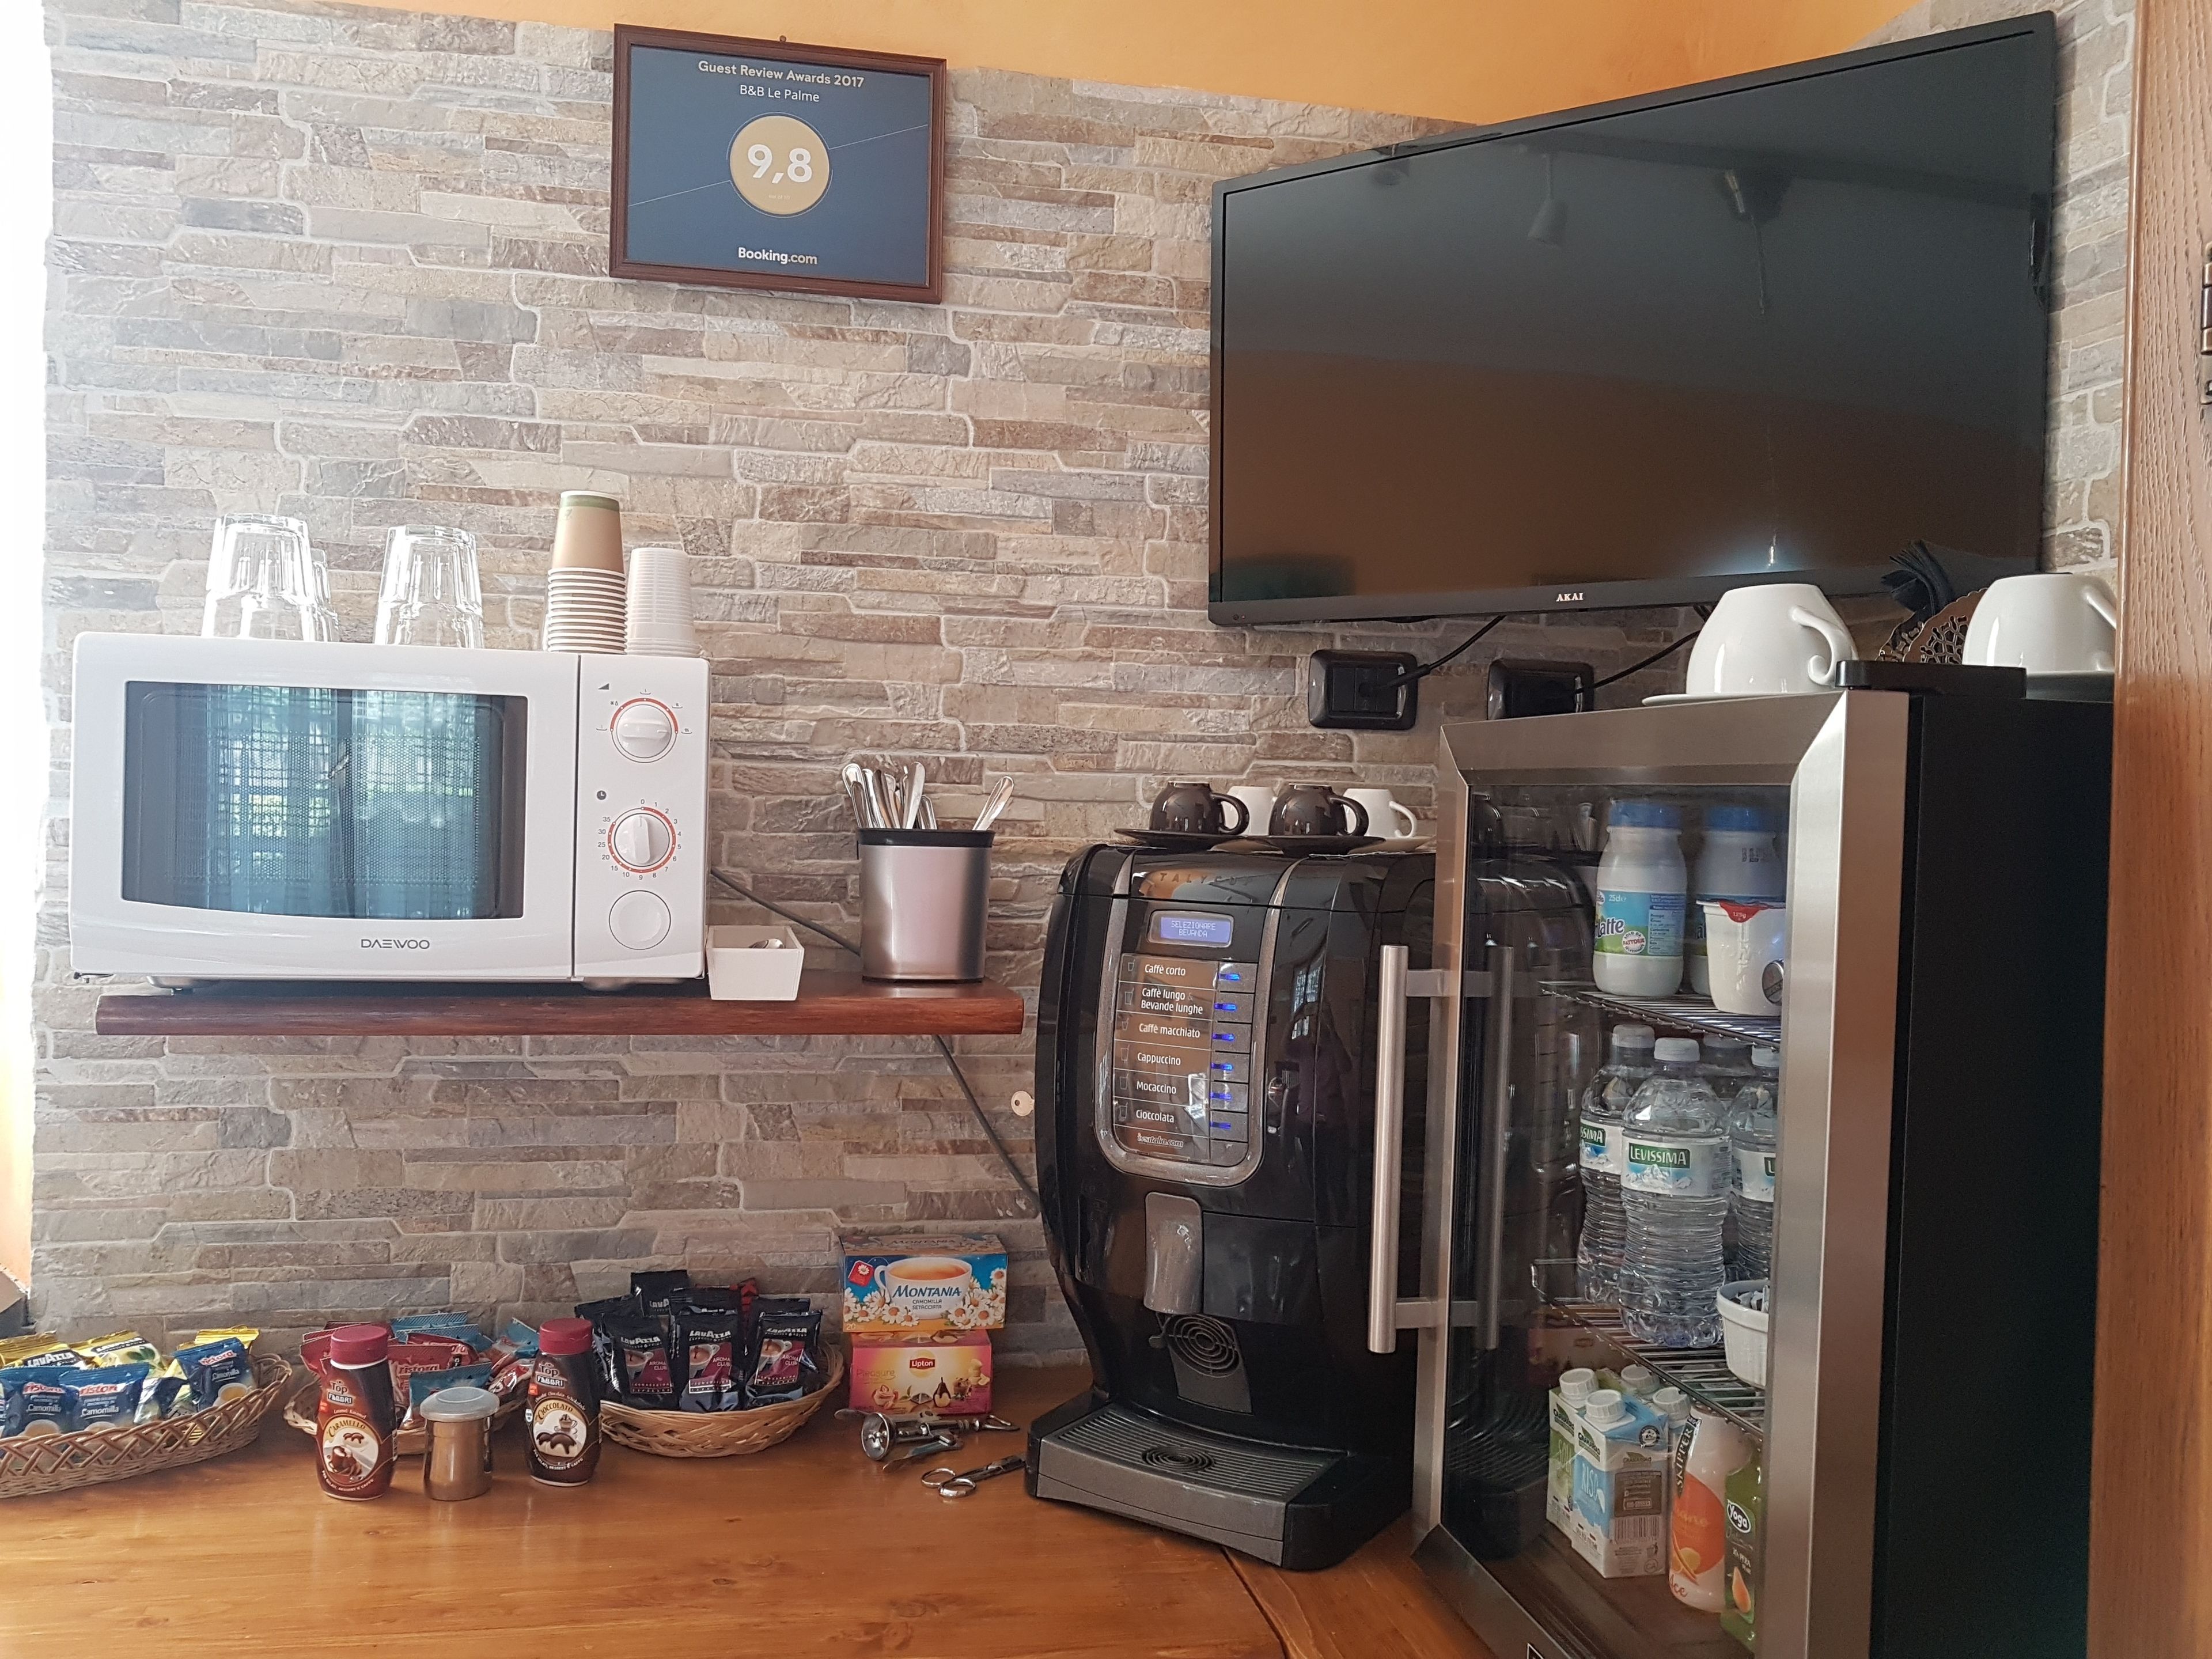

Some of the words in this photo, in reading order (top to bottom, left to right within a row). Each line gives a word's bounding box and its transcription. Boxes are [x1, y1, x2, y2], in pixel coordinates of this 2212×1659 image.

[698, 60, 737, 74] Guest
[740, 64, 783, 79] Review
[786, 70, 831, 85] Awards
[834, 74, 864, 88] 2017
[740, 85, 764, 96] B&B
[768, 87, 781, 99] Le
[785, 90, 820, 103] Palme
[748, 144, 812, 184] 9,8
[738, 247, 818, 265] Booking.com
[1556, 592, 1584, 602] AKAI
[1179, 929, 1207, 938] BEVANDA
[361, 939, 430, 949] DAEWOO
[1145, 964, 1164, 974] Caffè
[1165, 967, 1185, 976] corto
[1142, 987, 1161, 998] Caffè
[1162, 989, 1185, 1001] lungo
[1141, 999, 1173, 1011] Bevande
[1176, 1002, 1203, 1014] lunghe
[1139, 1022, 1158, 1033] Caffè
[1160, 1026, 1200, 1038] macchiato
[1137, 1052, 1181, 1066] Cappuccino
[1136, 1081, 1176, 1094] Mocaccino
[1135, 1109, 1175, 1123] Cioccolata
[1630, 1145, 1687, 1166] LEVISSIMA
[892, 1285, 962, 1298] MONTANIA
[620, 1336, 661, 1345] LAVAZZA
[690, 1330, 732, 1339] LAVAZZA
[540, 1365, 558, 1377] Top
[331, 1382, 347, 1394] Top
[537, 1376, 563, 1386] FABBRI
[328, 1393, 352, 1404] FABBRI
[81, 1406, 119, 1416] Camomilla
[537, 1403, 573, 1420] CIOCCOLATO
[328, 1420, 366, 1437] CARAMELLO
[1676, 1428, 1692, 1489] SKIPPER
[1729, 1504, 1748, 1528] Yoga
